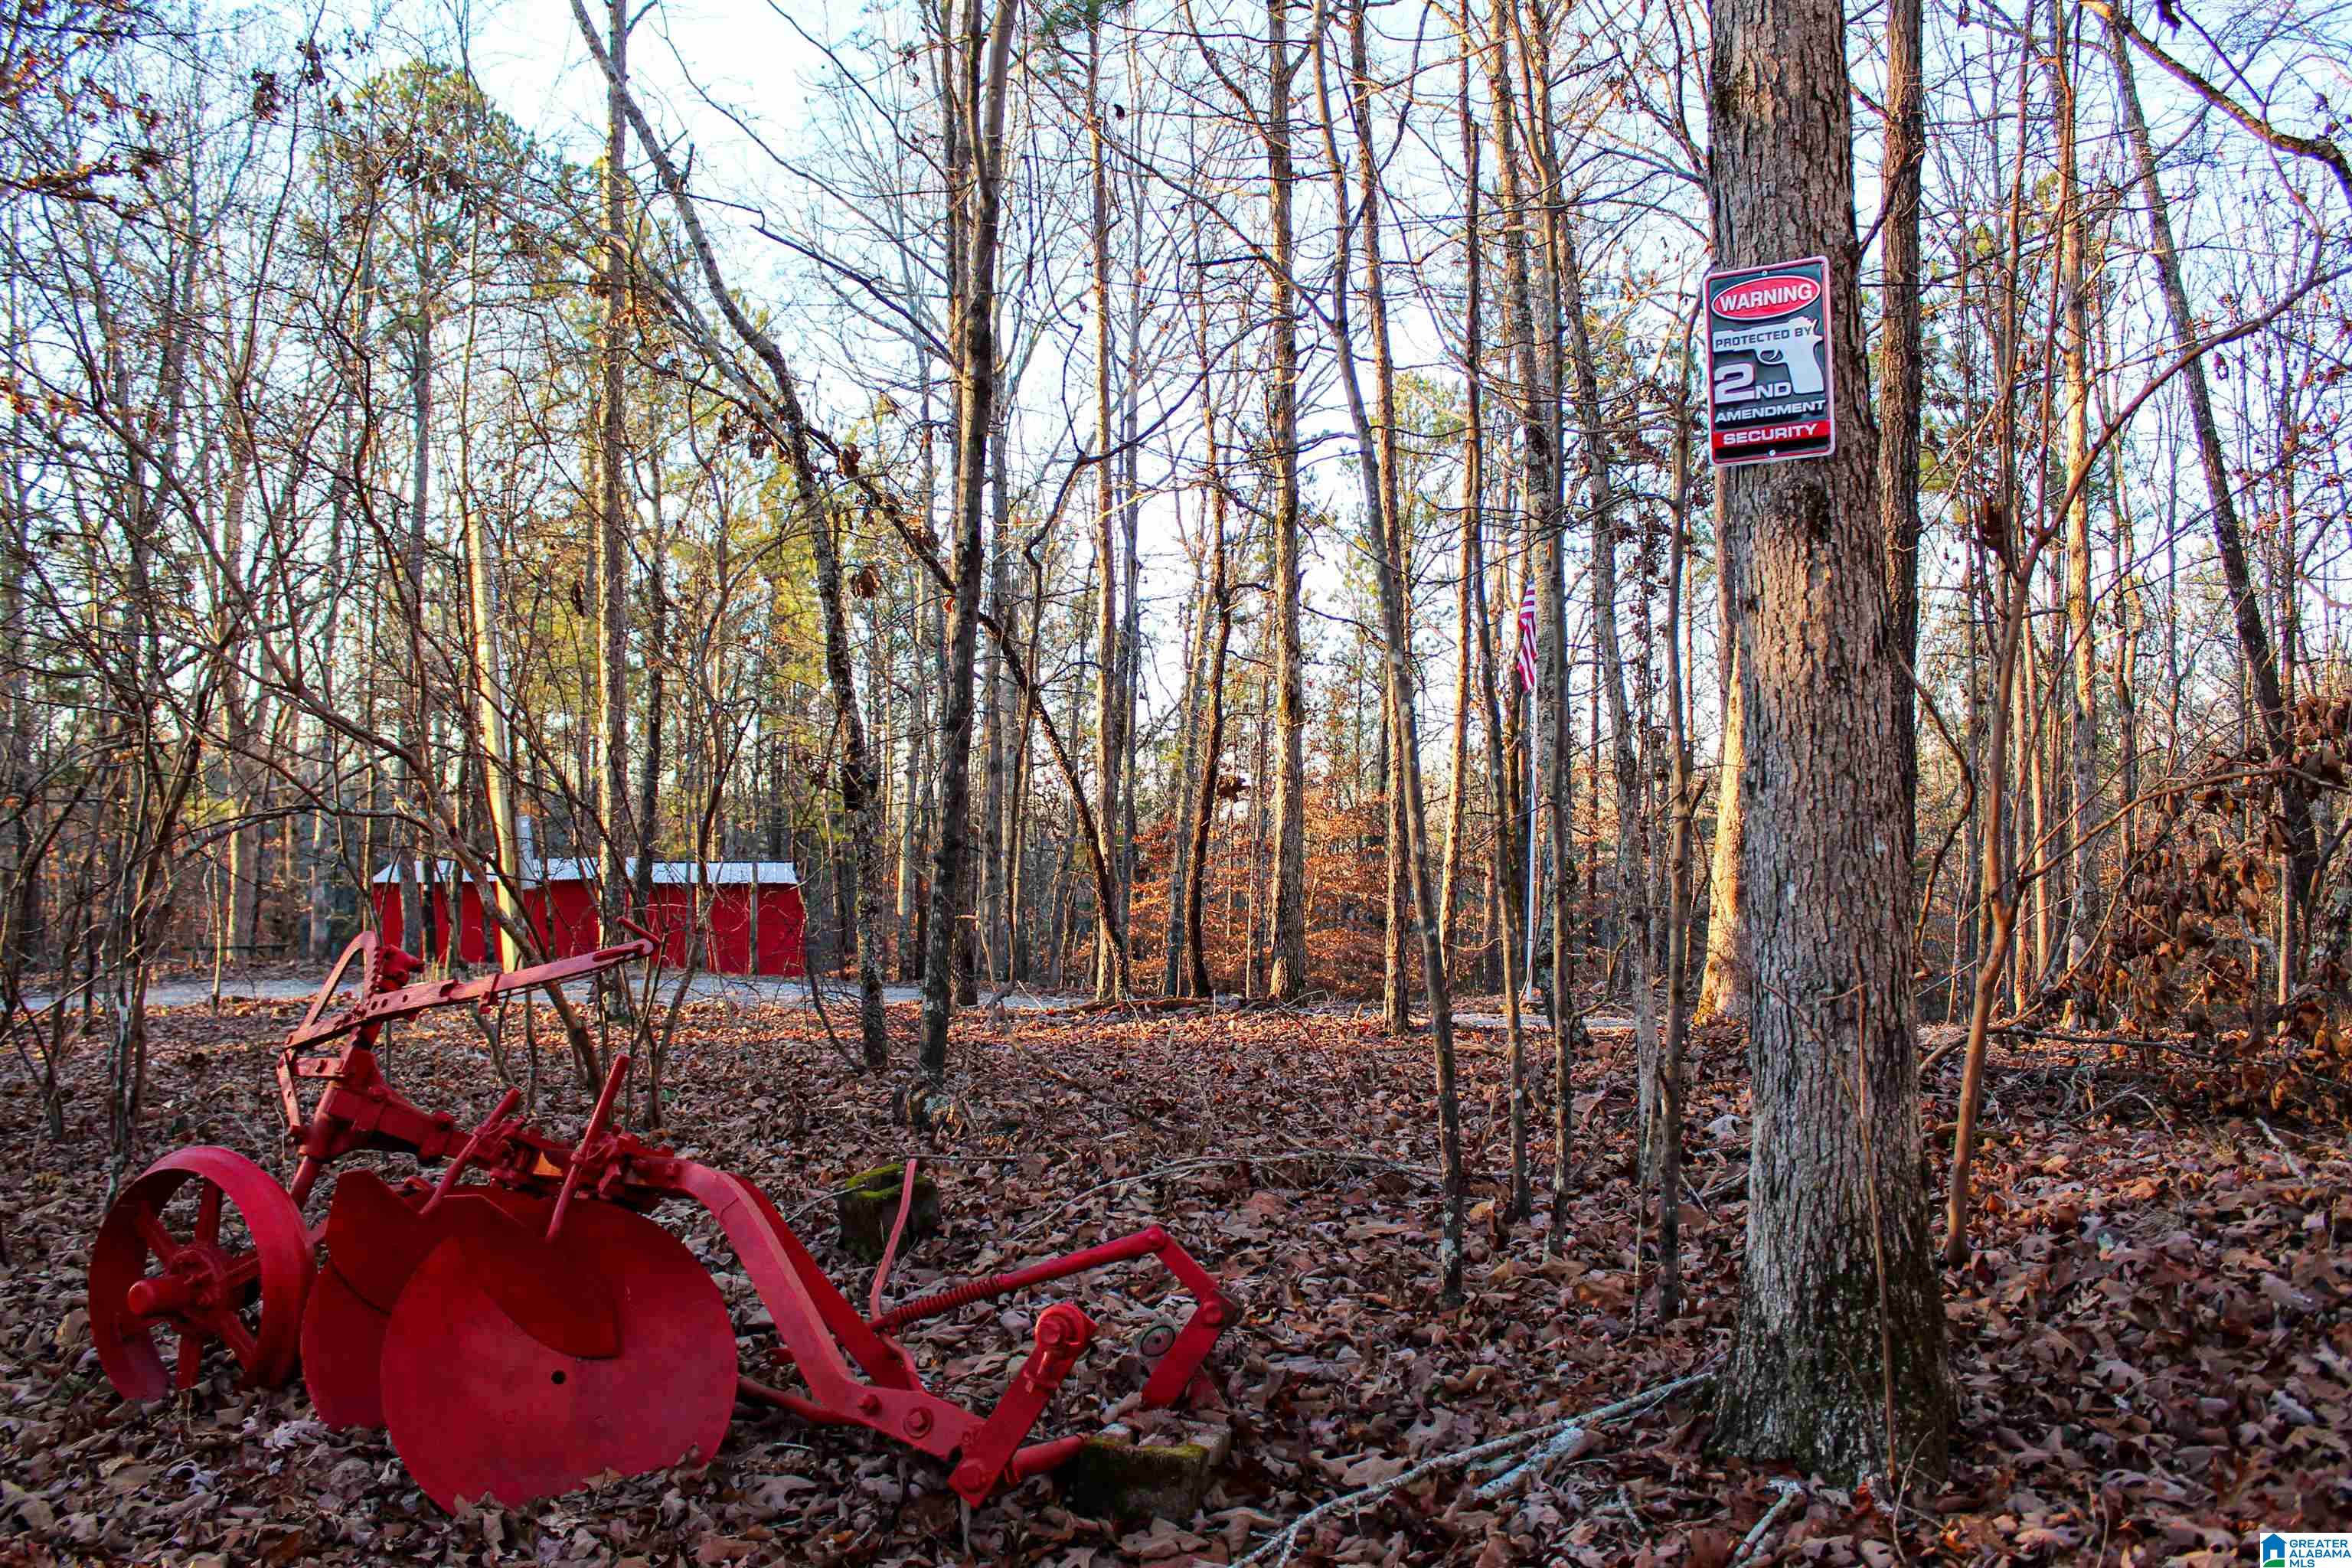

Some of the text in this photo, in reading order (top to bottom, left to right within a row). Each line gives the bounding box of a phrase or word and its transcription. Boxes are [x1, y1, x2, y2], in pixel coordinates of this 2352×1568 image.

[1720, 283, 1813, 312] WARNING
[1715, 326, 1814, 348] PROTECTED BY
[1713, 364, 1792, 403] 2ND
[1715, 400, 1825, 423] AMENDMENT
[1723, 424, 1818, 445] SECURITY
